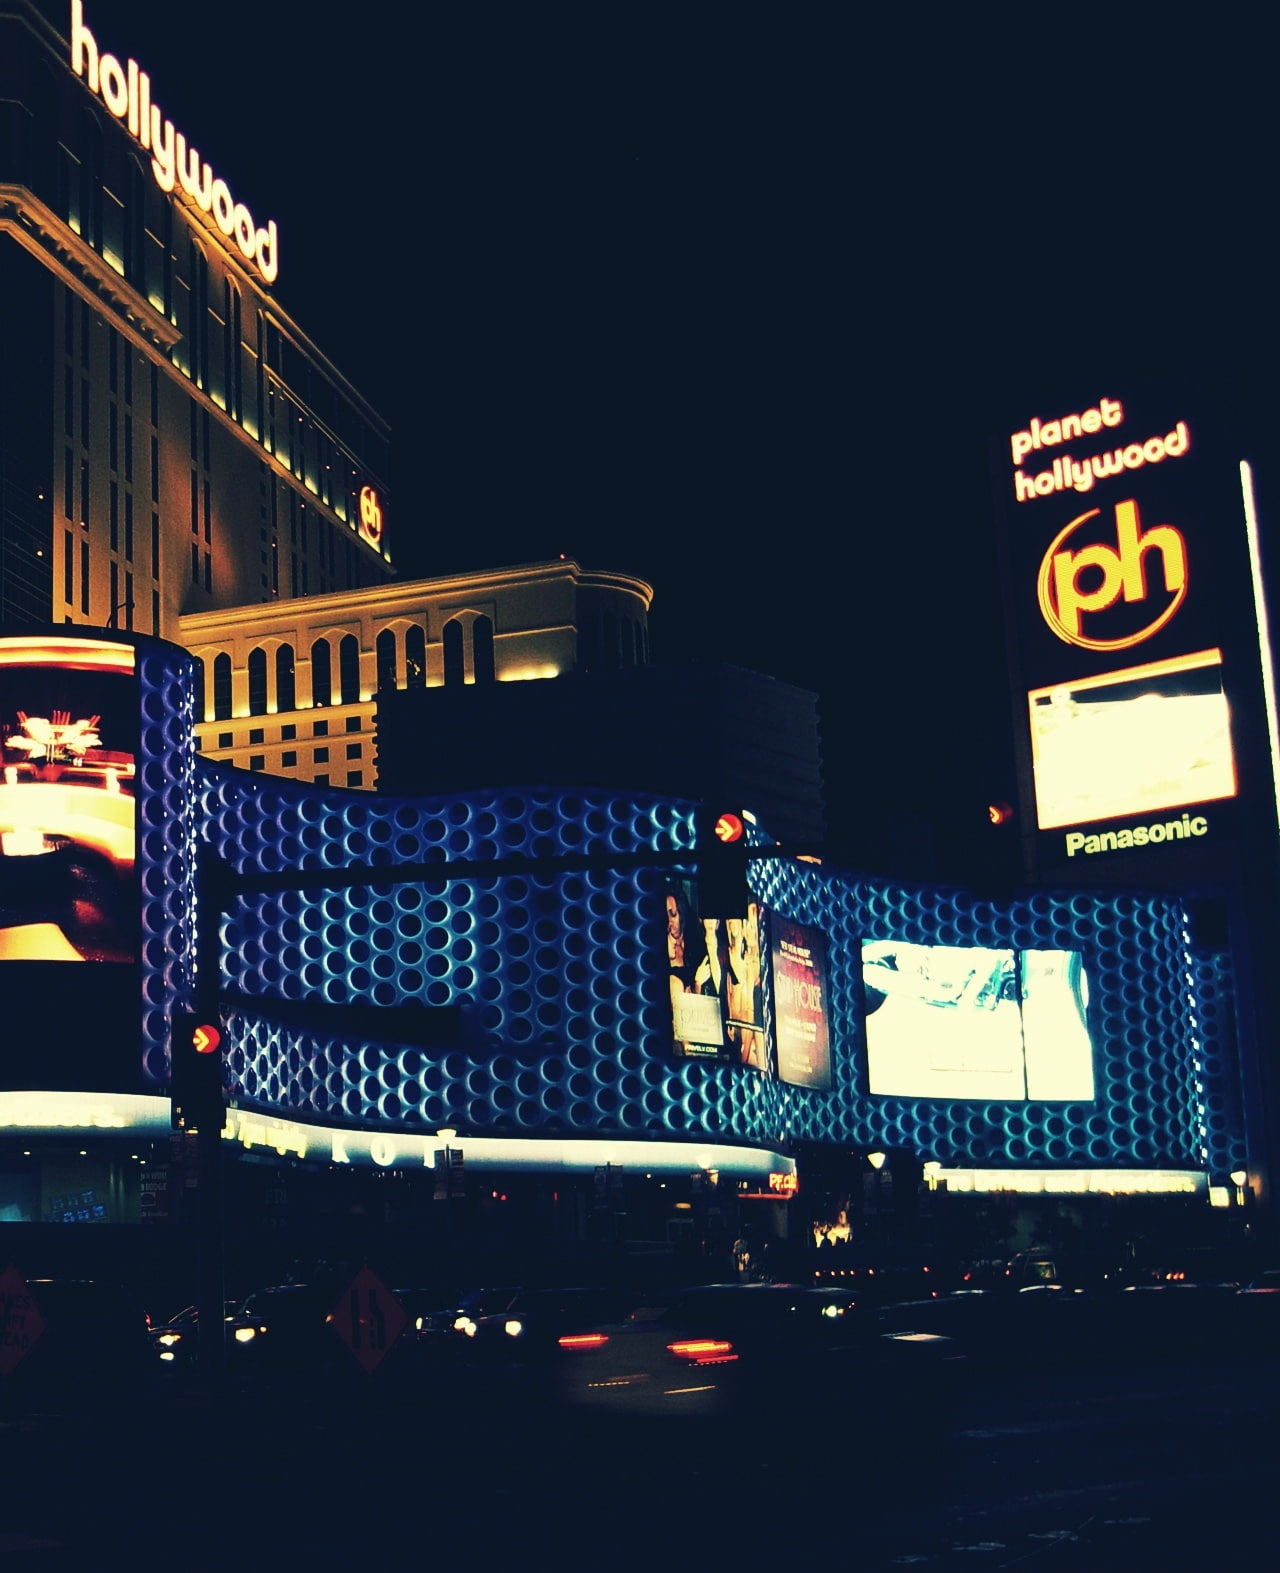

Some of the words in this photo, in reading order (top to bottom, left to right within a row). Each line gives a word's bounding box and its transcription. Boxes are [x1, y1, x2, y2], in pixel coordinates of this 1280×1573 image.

[71, 0, 278, 283] hollywood
[1011, 397, 1122, 465] planet
[1014, 421, 1189, 501] hollywood
[1052, 499, 1187, 637] ph
[1066, 813, 1208, 857] Panasonic
